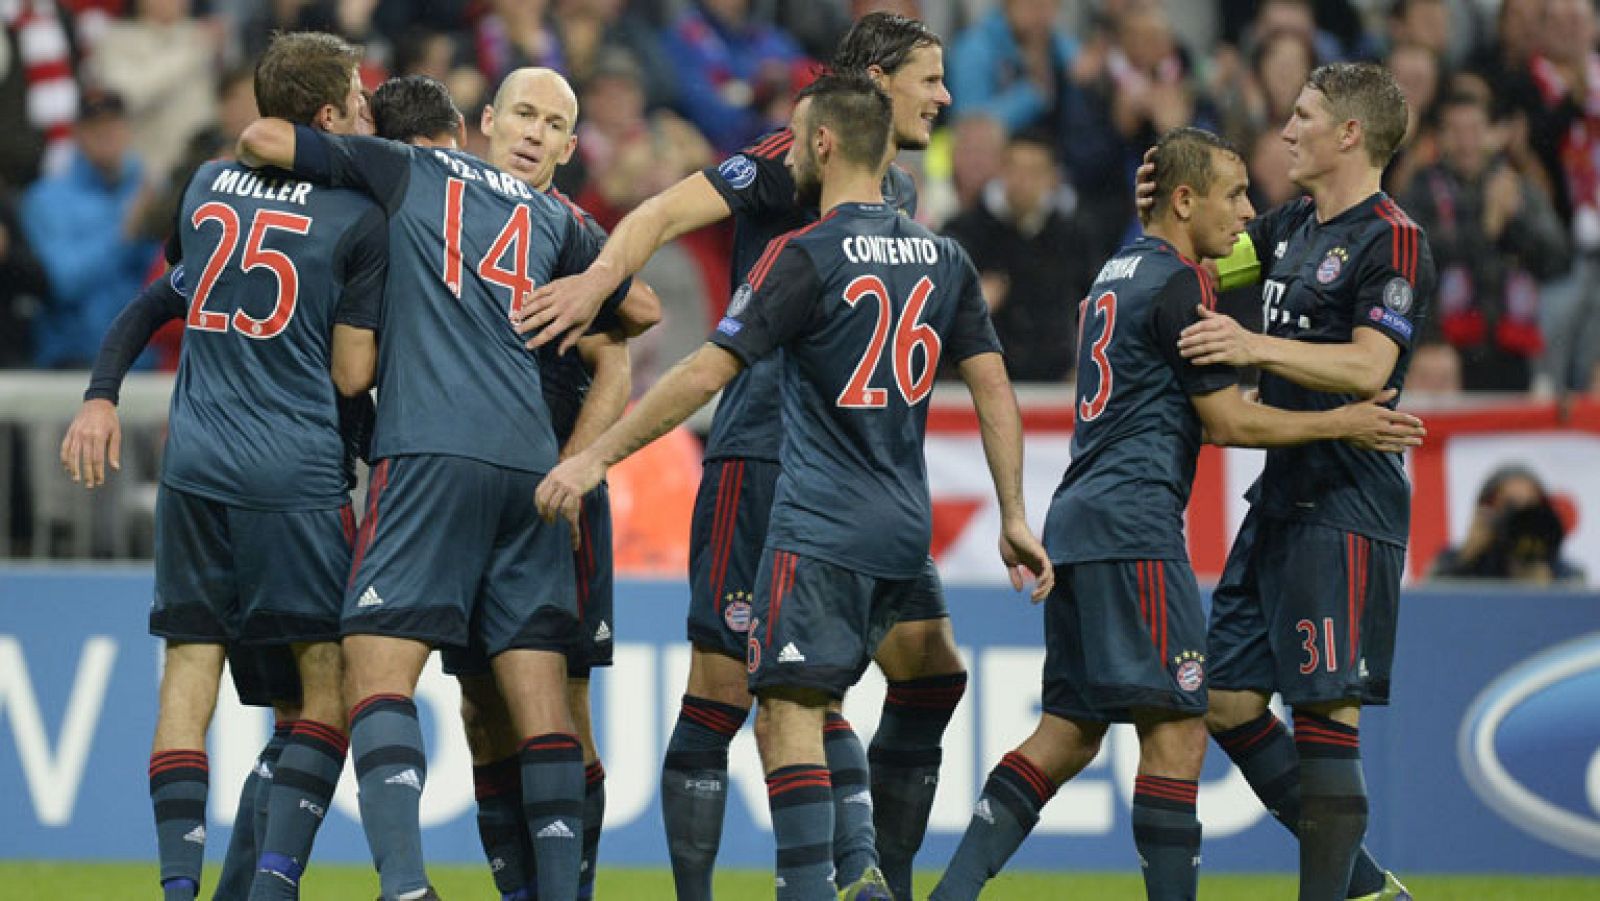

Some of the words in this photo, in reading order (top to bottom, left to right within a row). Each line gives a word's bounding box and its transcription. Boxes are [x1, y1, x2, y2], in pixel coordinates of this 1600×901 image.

[187, 201, 313, 340] 25
[443, 176, 536, 328] 14
[835, 274, 942, 408] 26
[1296, 616, 1337, 675] 31
[684, 779, 721, 792] FCB
